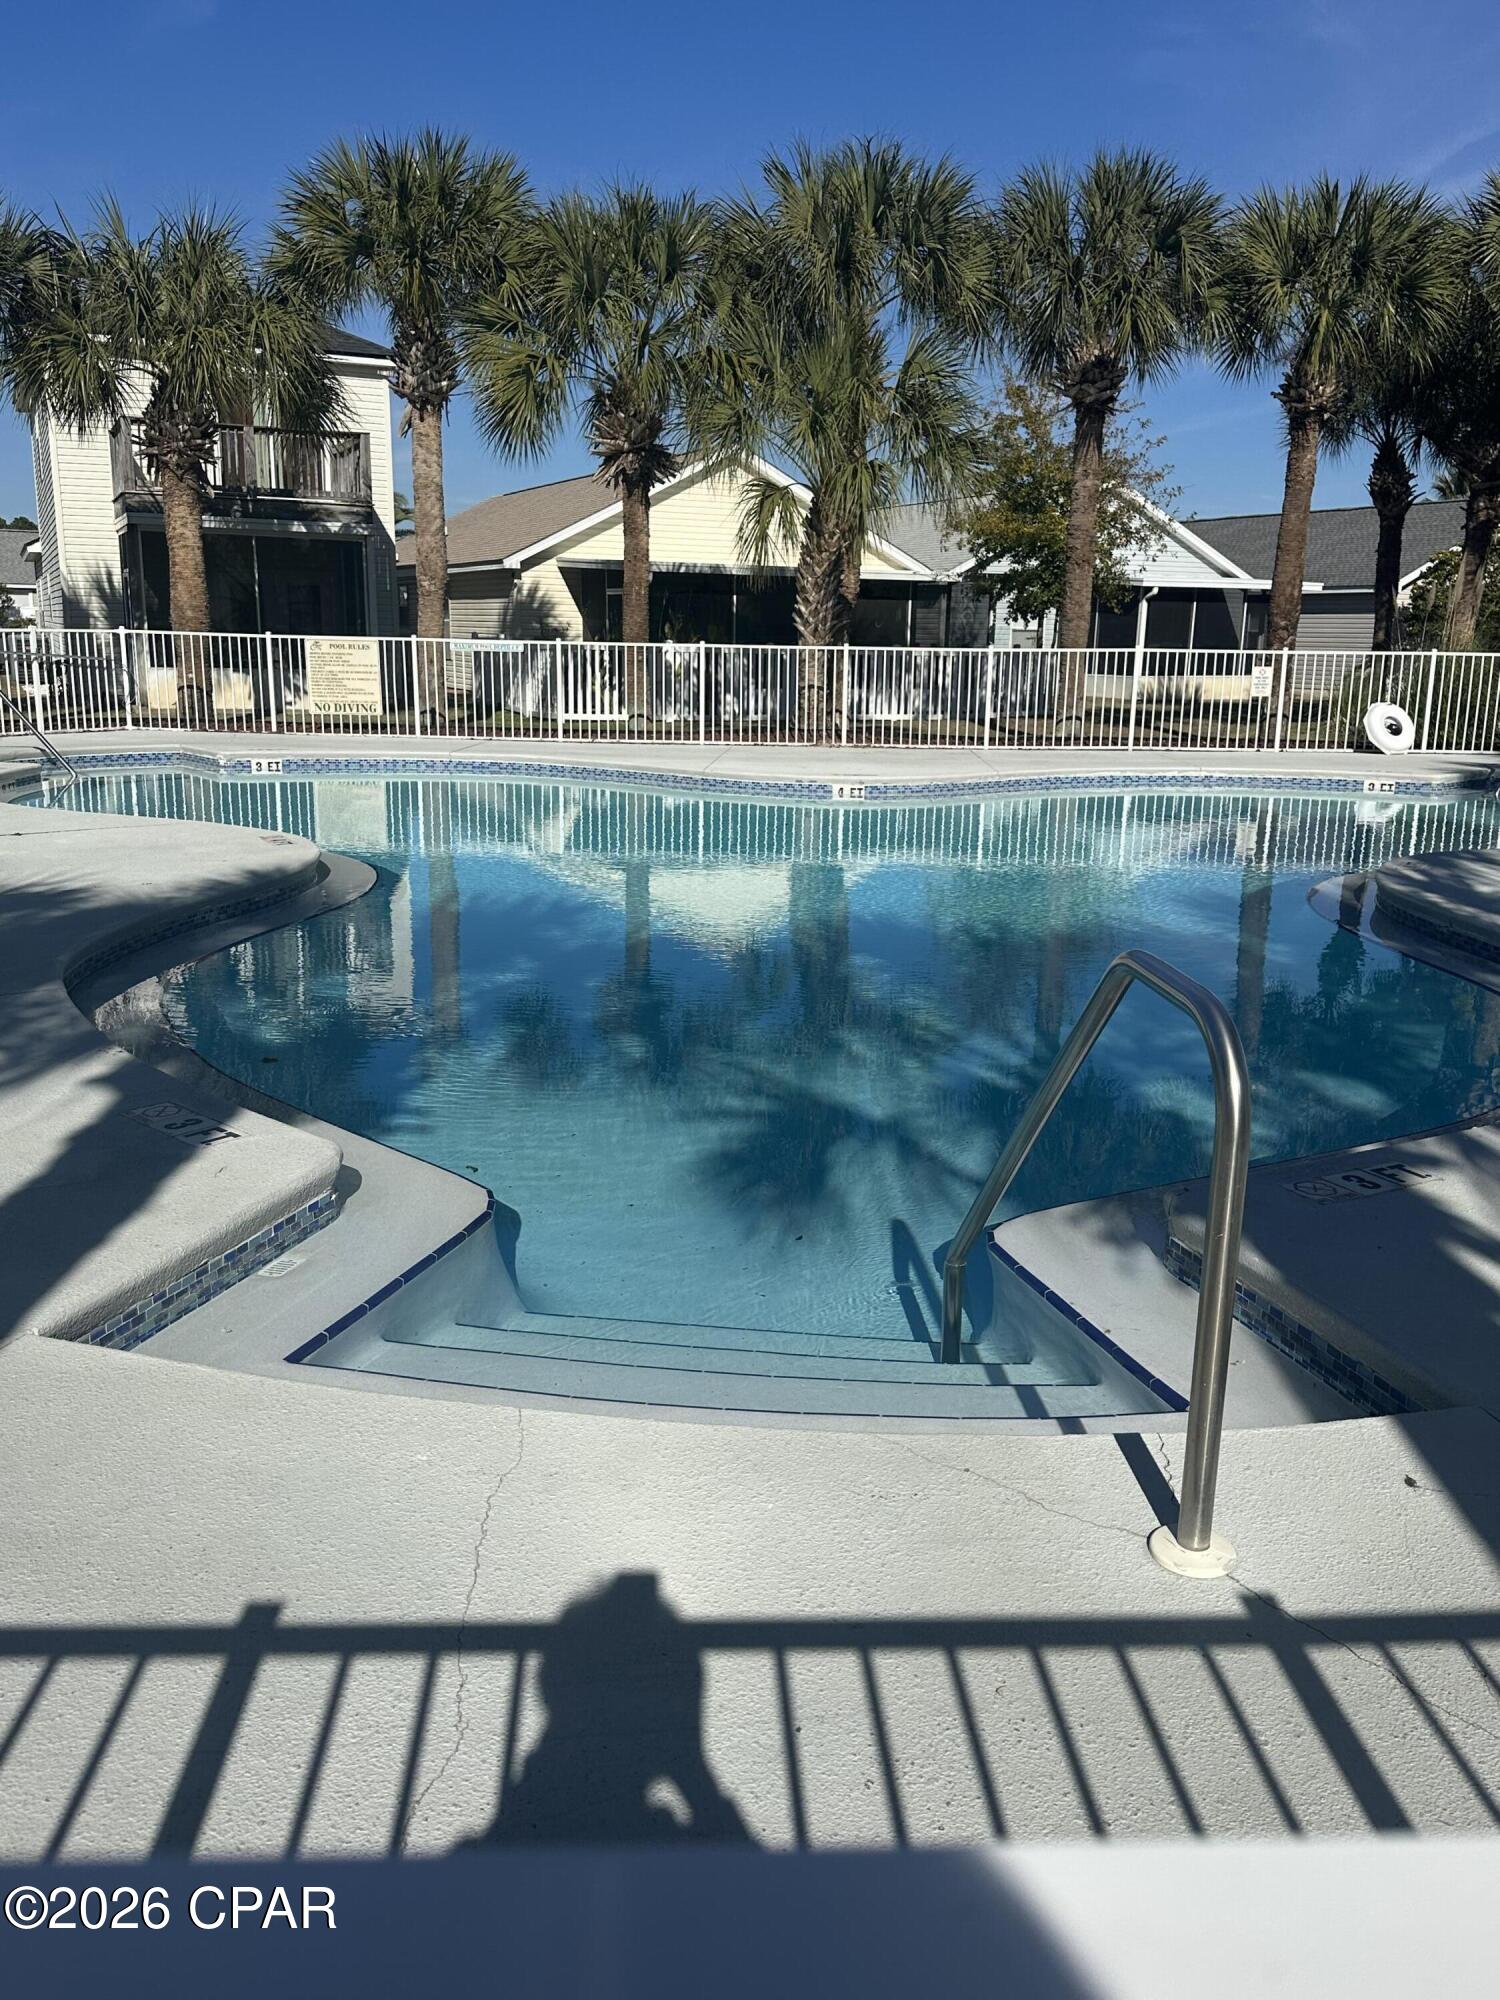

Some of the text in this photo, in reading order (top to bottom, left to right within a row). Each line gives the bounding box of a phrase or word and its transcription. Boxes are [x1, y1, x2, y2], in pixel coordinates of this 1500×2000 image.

[329, 643, 370, 651] POOL RULES
[314, 702, 377, 713] NO DIVING
[164, 1118, 203, 1130] 3
[1342, 1174, 1382, 1190] 3
